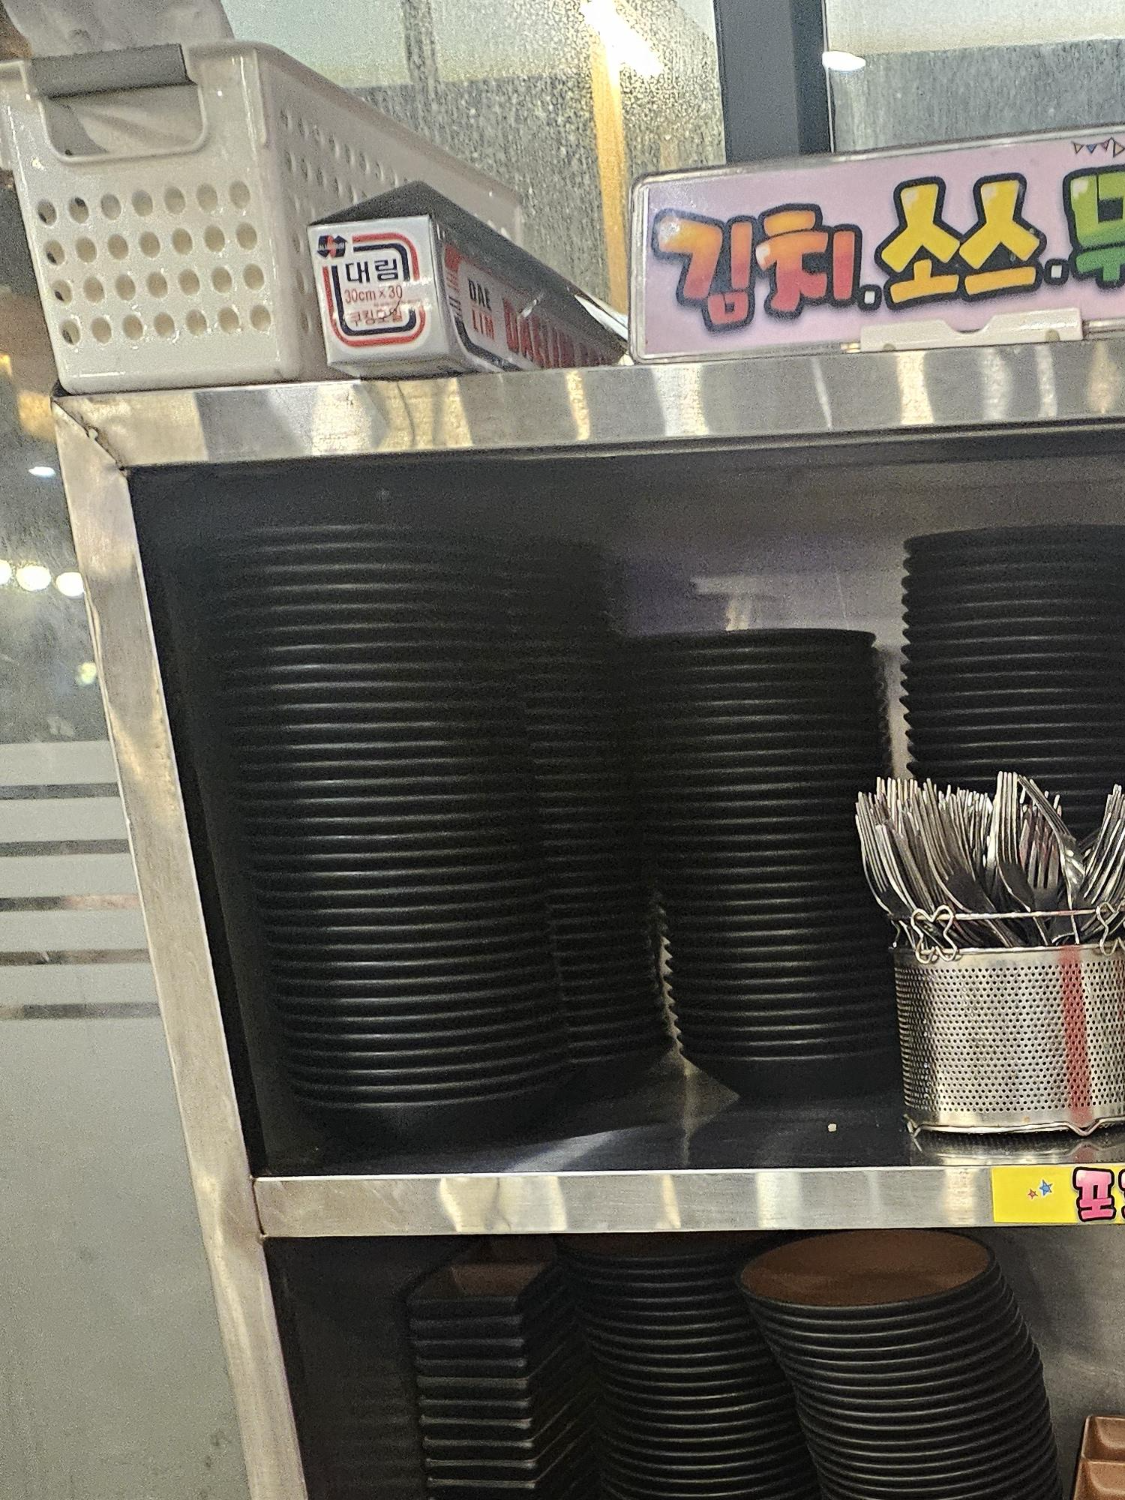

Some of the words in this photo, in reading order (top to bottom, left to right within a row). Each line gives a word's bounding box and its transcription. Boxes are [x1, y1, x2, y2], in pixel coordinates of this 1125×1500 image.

[345, 258, 399, 284] 대림
[344, 289, 376, 305] 30cm
[389, 284, 403, 299] 30
[468, 279, 492, 311] DAE
[471, 308, 495, 341] LIM
